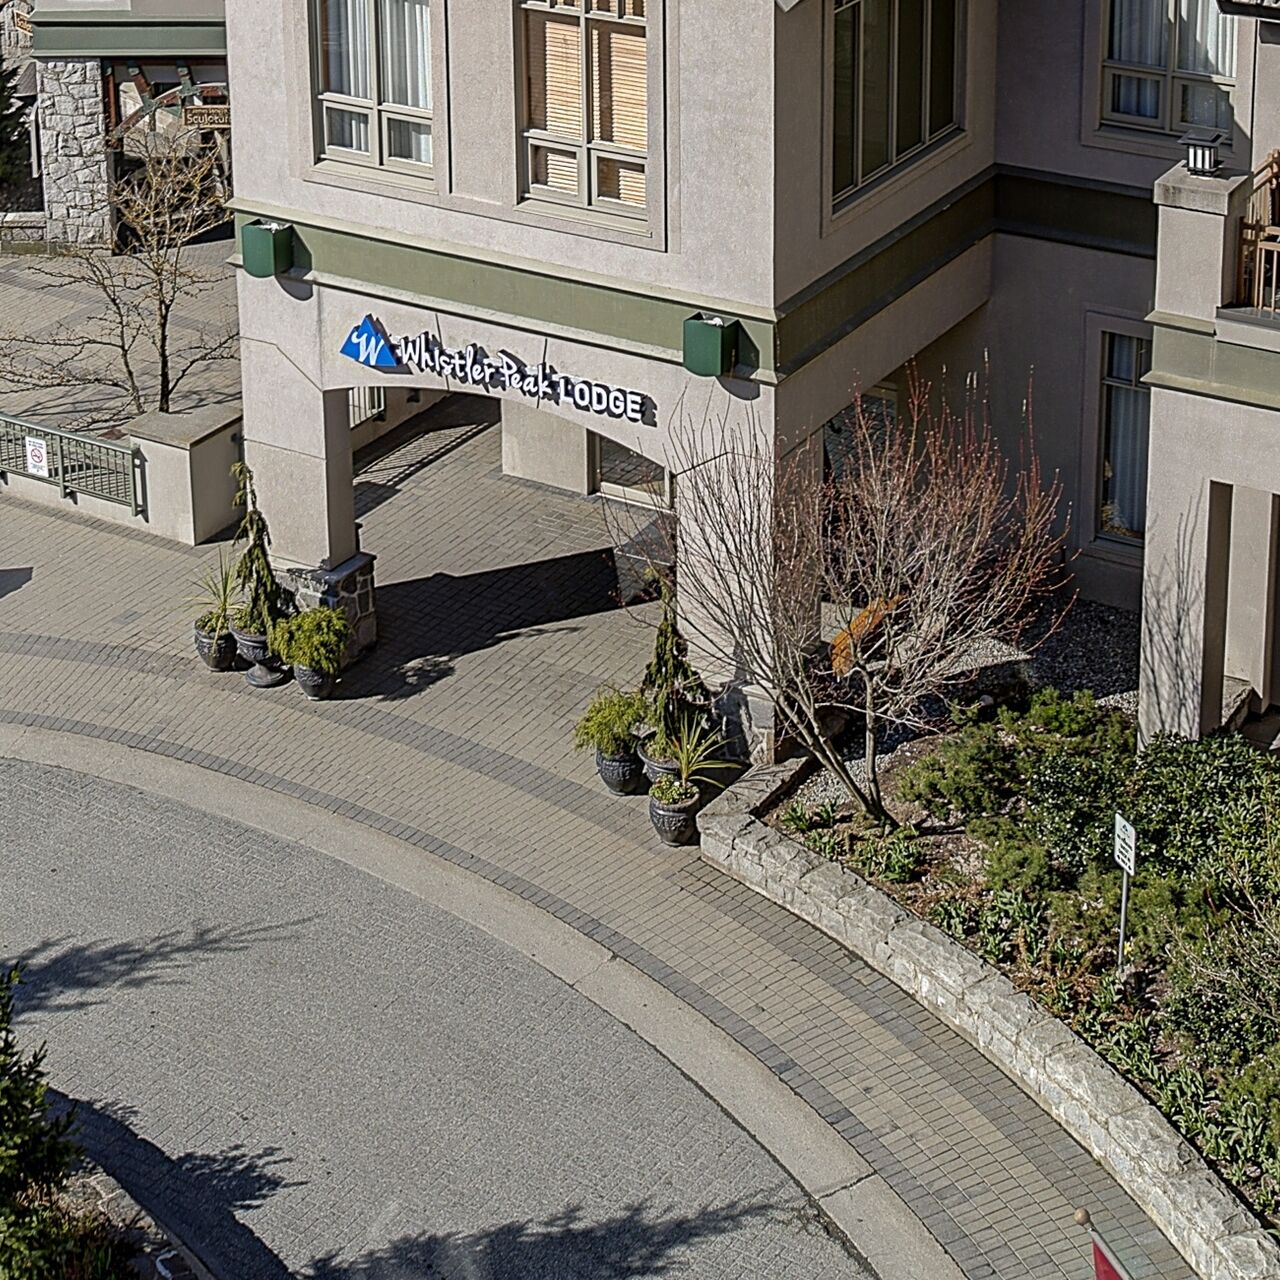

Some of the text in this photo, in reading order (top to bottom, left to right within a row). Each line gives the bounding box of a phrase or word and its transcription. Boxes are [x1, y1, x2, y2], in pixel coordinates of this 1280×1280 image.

[398, 333, 642, 420] Whistler Peak LODGE
